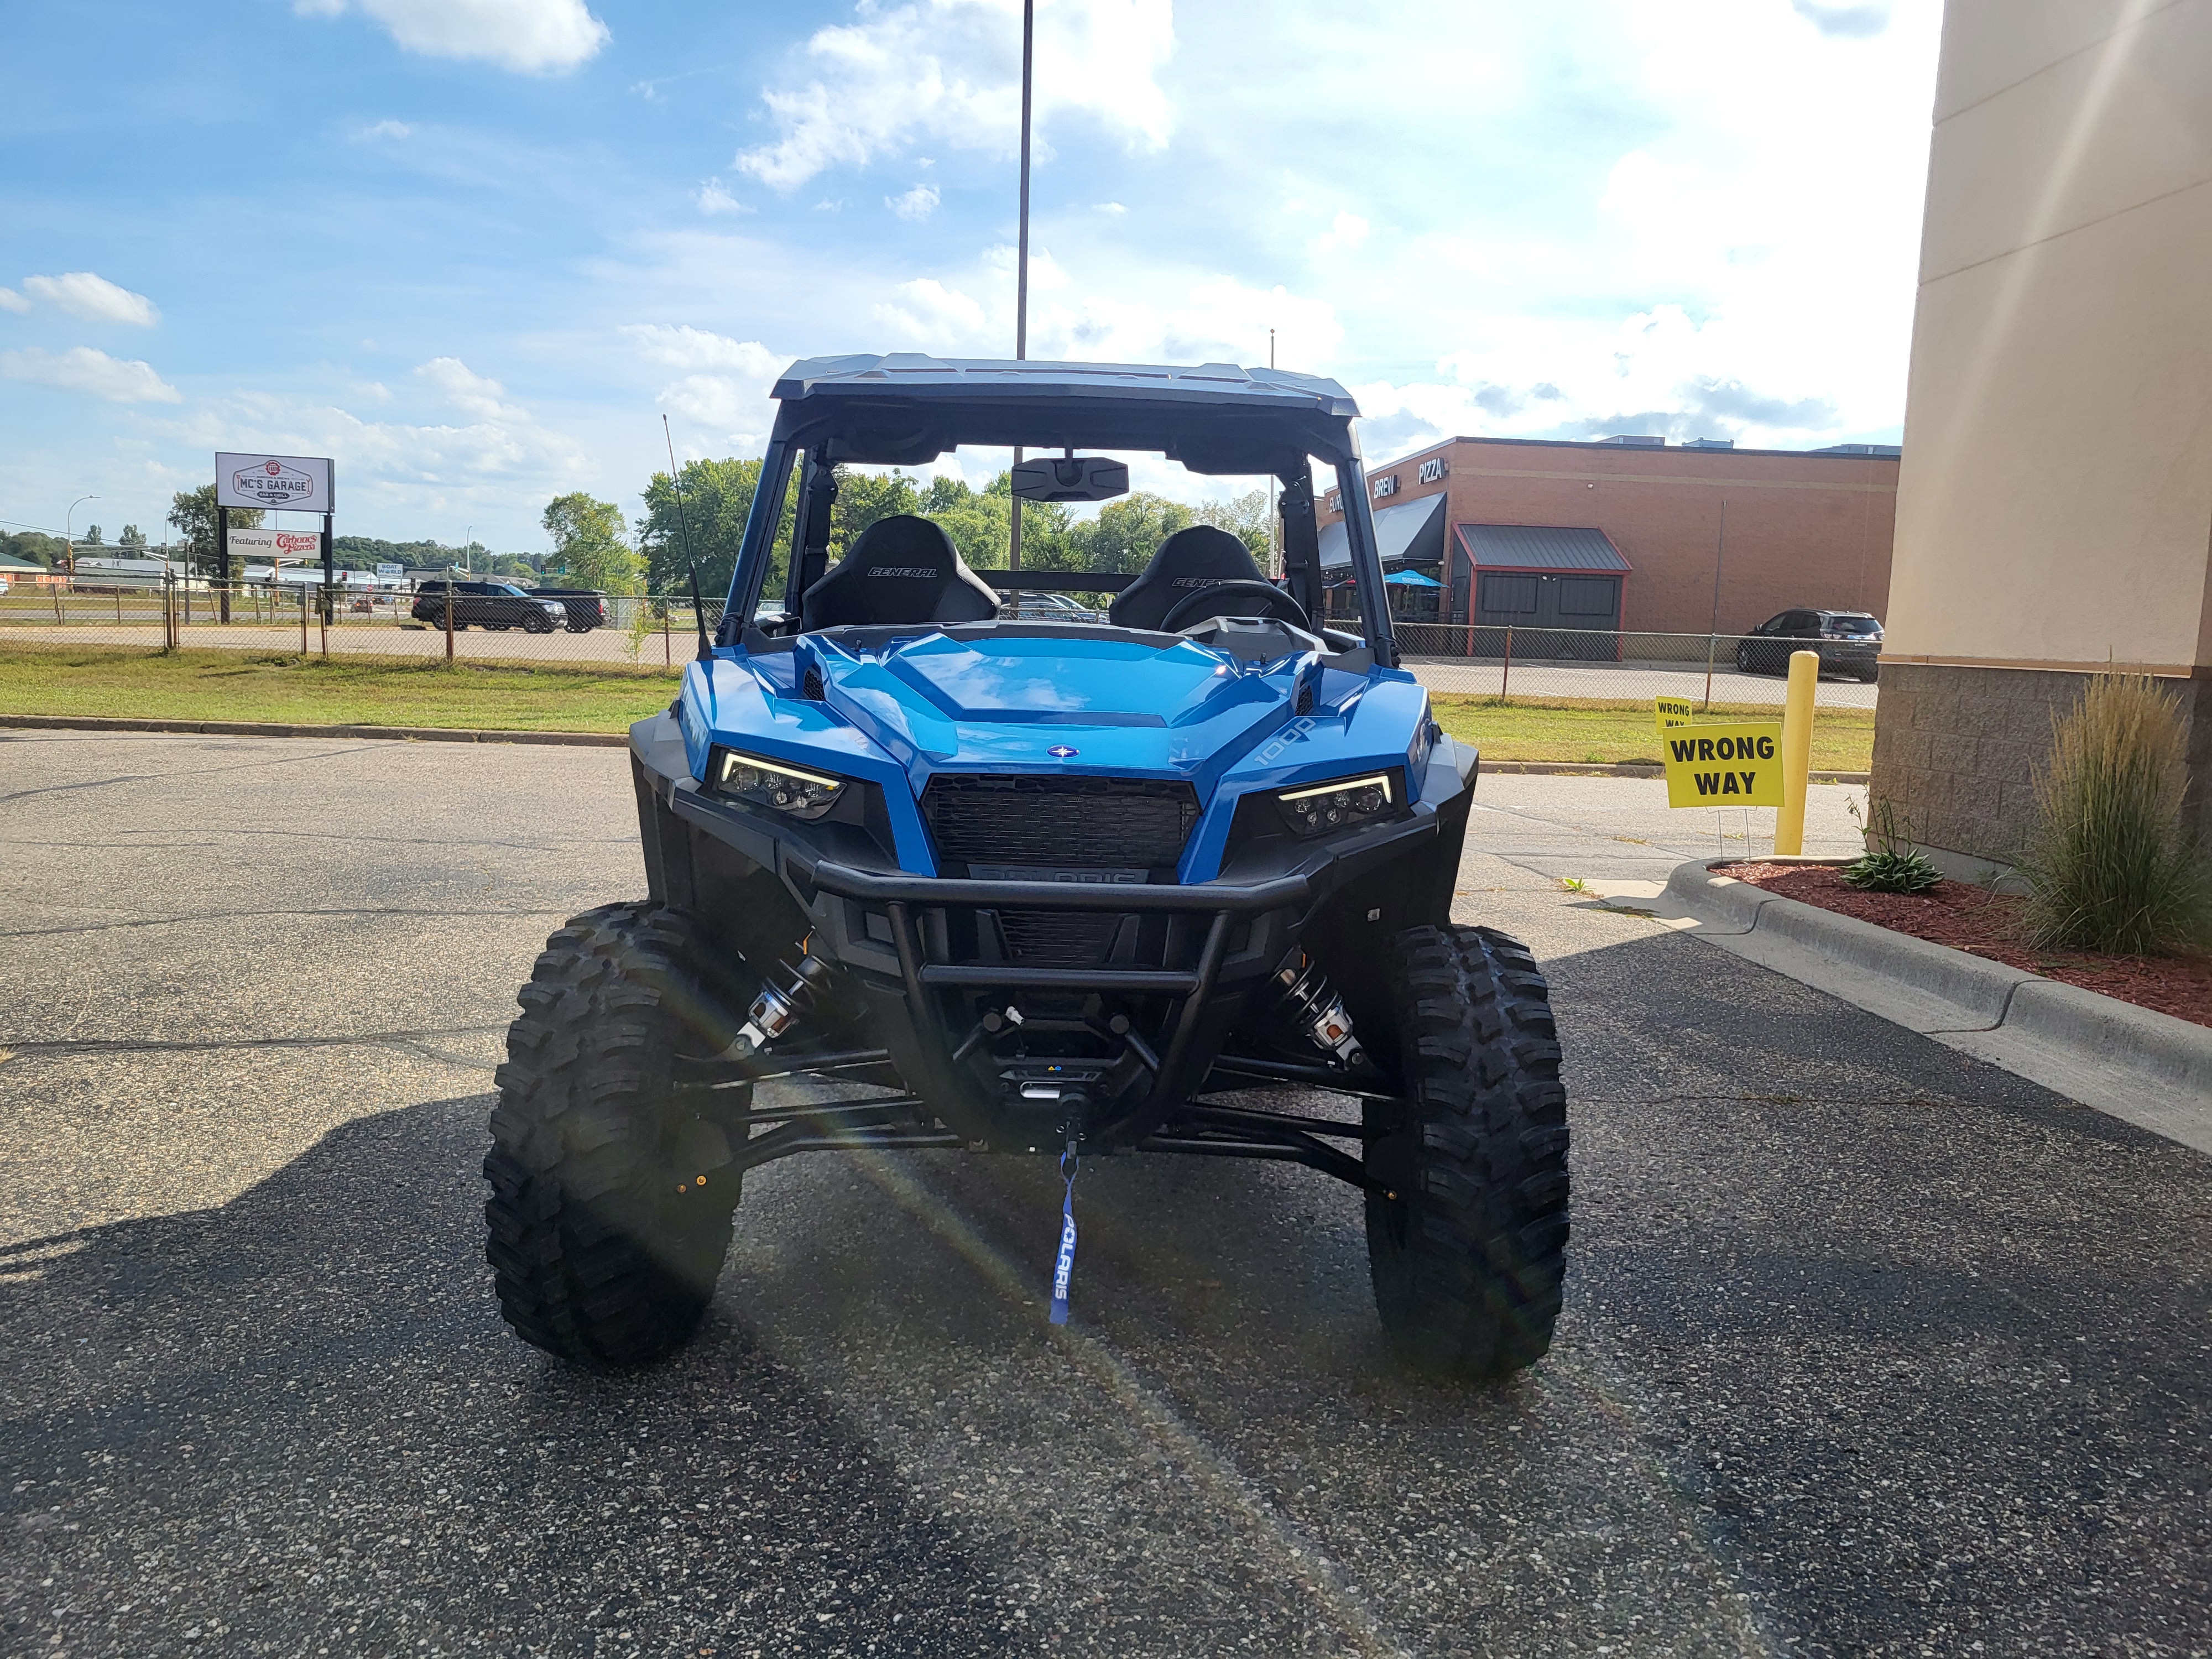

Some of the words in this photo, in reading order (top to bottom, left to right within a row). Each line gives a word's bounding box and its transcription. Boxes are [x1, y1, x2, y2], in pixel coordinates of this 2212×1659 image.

[1418, 458, 1442, 485] PIZZA
[240, 478, 263, 489] MC'S
[267, 480, 306, 492] GARAGE
[1374, 474, 1394, 499] BREW
[229, 536, 272, 548] Featuring
[868, 567, 938, 578] GENERAL
[1657, 702, 1690, 717] WRONG
[1254, 717, 1317, 766] 1000
[1670, 736, 1775, 763] WRONG
[1694, 771, 1756, 796] WAY
[1055, 1213, 1076, 1300] POLARIS
